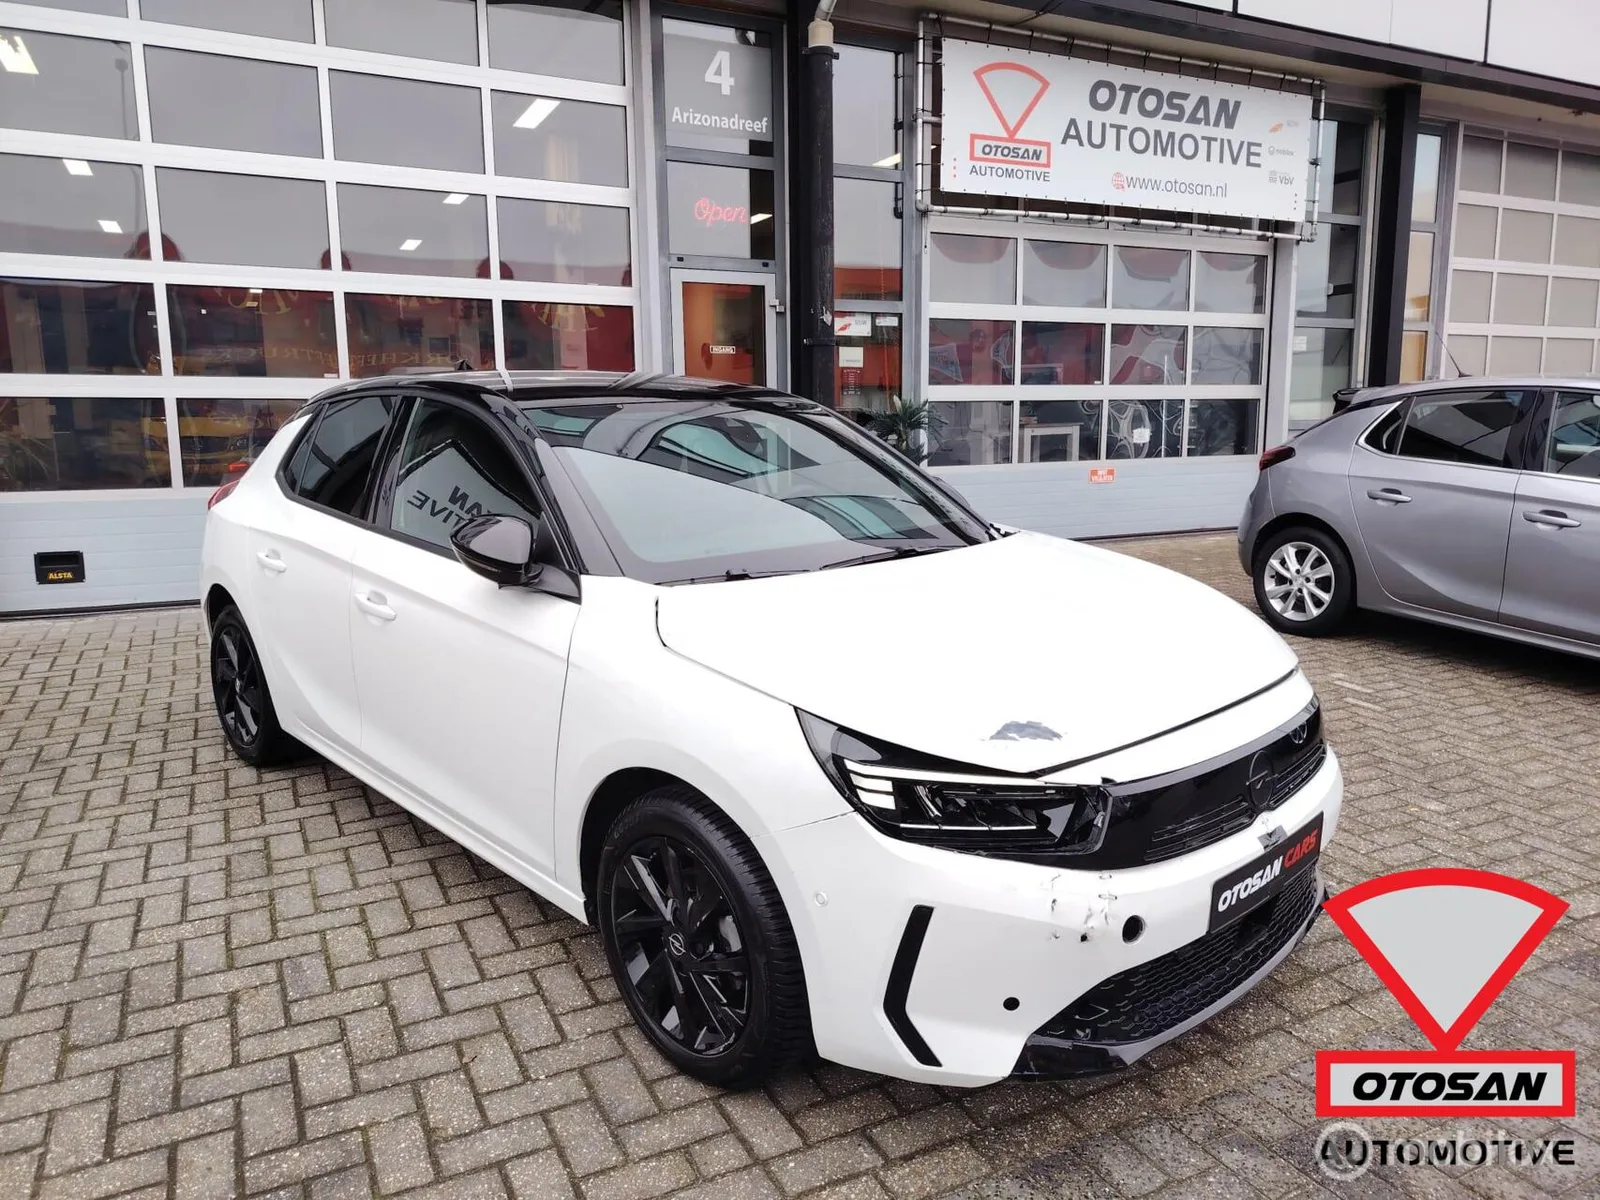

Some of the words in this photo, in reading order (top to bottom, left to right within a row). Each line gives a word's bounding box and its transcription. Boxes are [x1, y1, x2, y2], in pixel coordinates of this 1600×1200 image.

[704, 50, 735, 96] 4
[1088, 79, 1241, 130] OTOSAN
[671, 106, 769, 134] Arizonadreef
[981, 143, 1043, 161] OTOSAN
[1060, 117, 1262, 168] AUTOMOTIVE
[969, 164, 1051, 182] AUTOMOTIVE
[1126, 175, 1228, 198] www.otosan.nl
[693, 196, 748, 227] Open
[48, 572, 73, 580] ALSTA
[1217, 855, 1284, 912] OTOSAN
[1283, 828, 1320, 868] CARS
